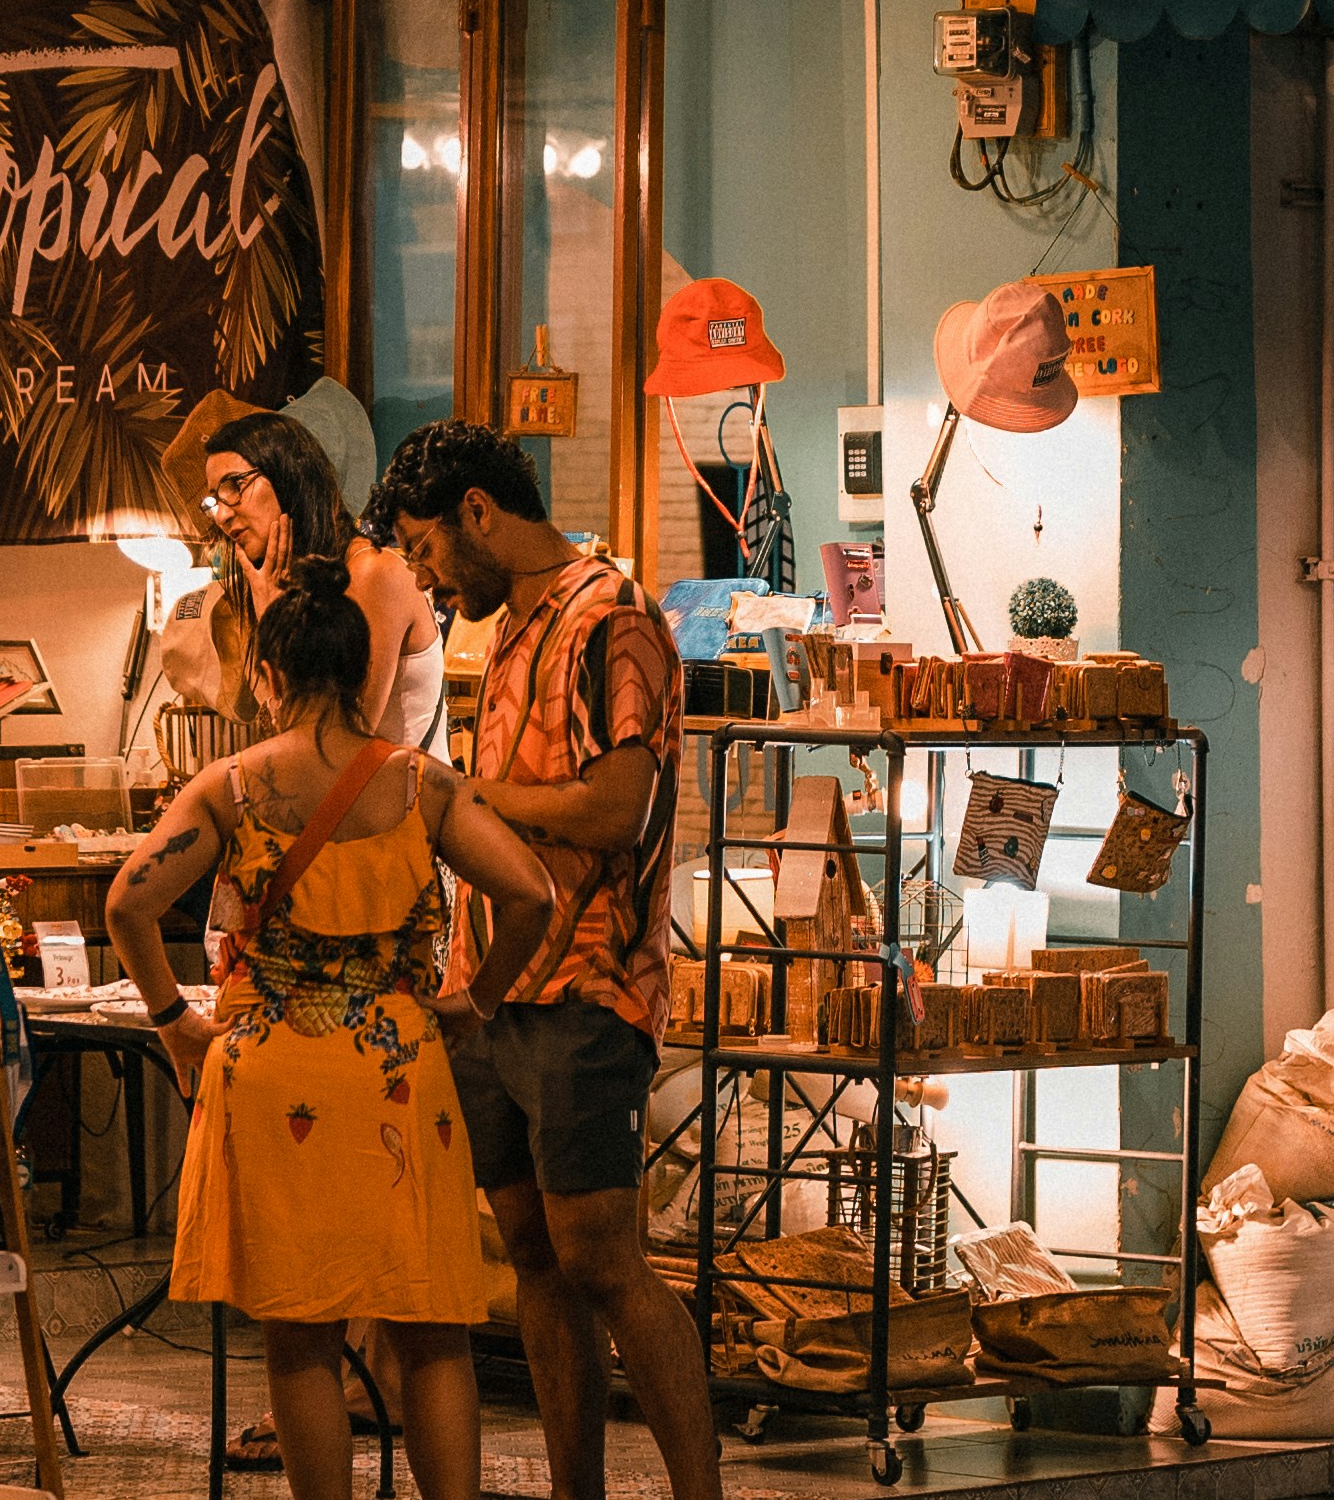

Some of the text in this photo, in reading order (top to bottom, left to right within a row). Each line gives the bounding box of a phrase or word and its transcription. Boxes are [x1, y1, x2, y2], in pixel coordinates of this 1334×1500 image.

[1092, 308, 1136, 327] CORK
[1097, 357, 1139, 375] LOGO
[522, 386, 556, 404] FREE
[55, 966, 65, 986] 3
